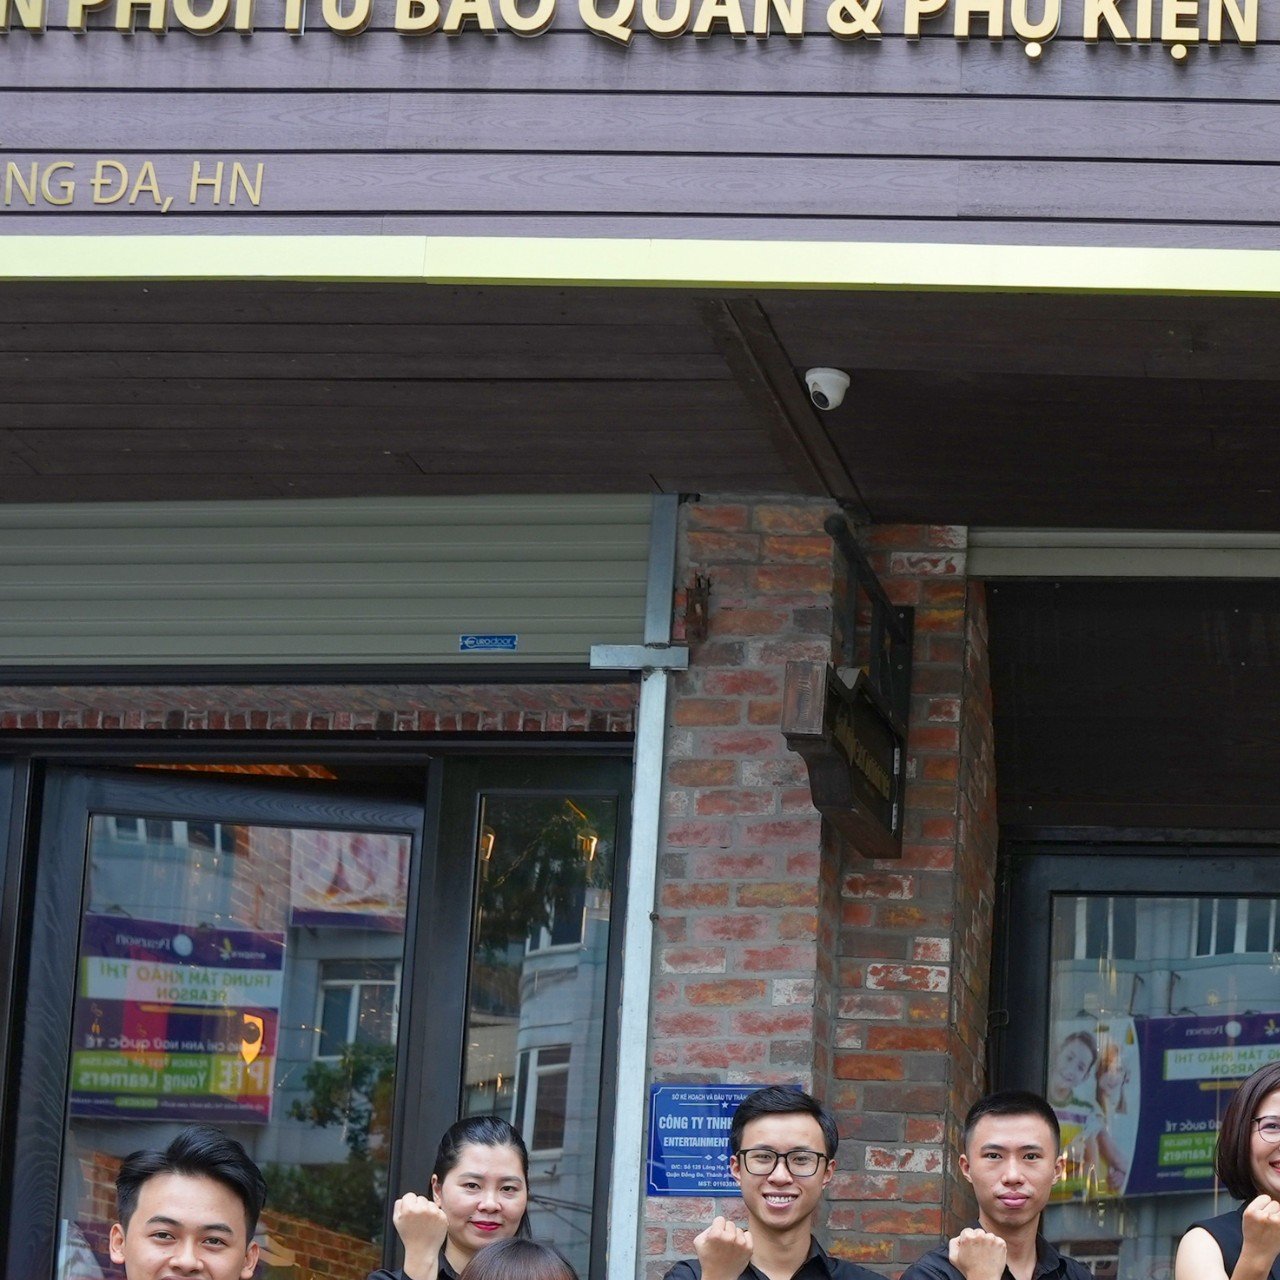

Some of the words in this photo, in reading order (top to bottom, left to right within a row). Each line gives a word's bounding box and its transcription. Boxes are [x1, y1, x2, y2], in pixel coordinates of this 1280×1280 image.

[90, 161, 173, 212] ĐA,
[189, 162, 264, 206] HN
[659, 1114, 688, 1130] CÔNG
[691, 1116, 704, 1130] TY
[663, 1136, 730, 1148] ENTERTAINMENT
